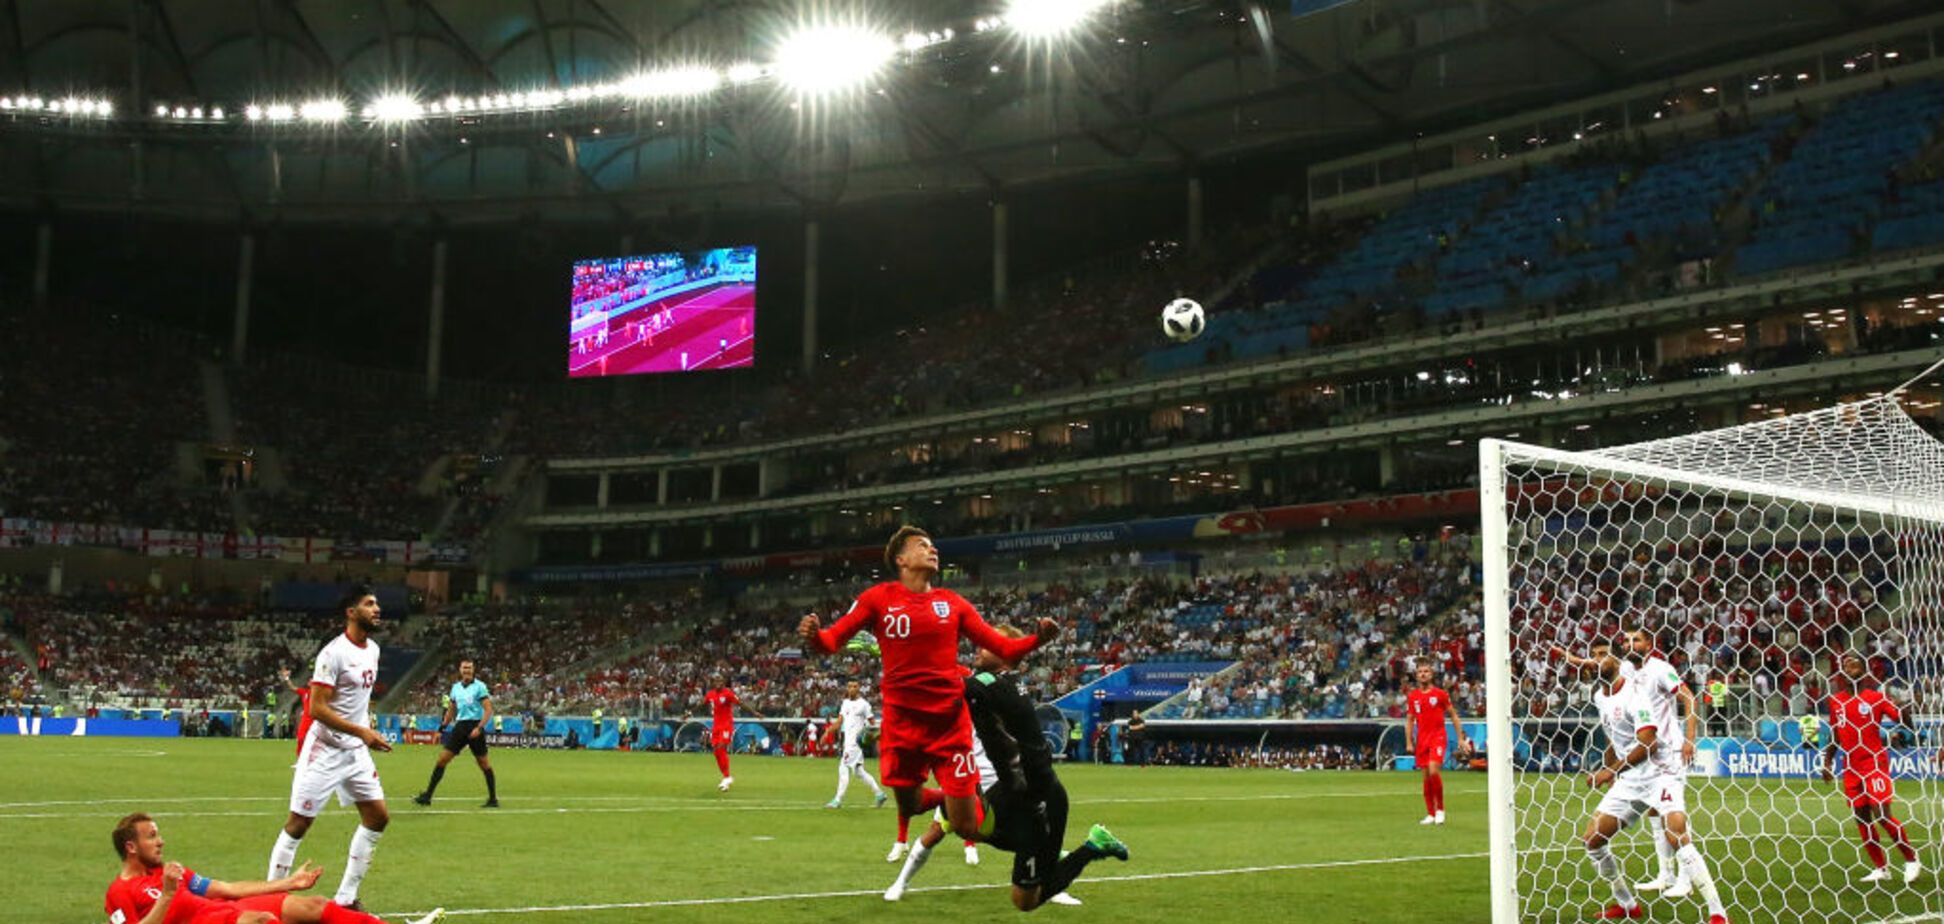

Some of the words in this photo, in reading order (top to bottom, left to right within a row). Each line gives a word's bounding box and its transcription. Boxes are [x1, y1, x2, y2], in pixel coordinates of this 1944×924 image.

[883, 613, 911, 639] 20
[362, 669, 373, 690] 13
[952, 751, 976, 778] 20
[1729, 753, 1804, 774] GAZPROM
[1660, 788, 1673, 802] 4
[1871, 778, 1886, 793] 10
[1026, 856, 1036, 878] 1
